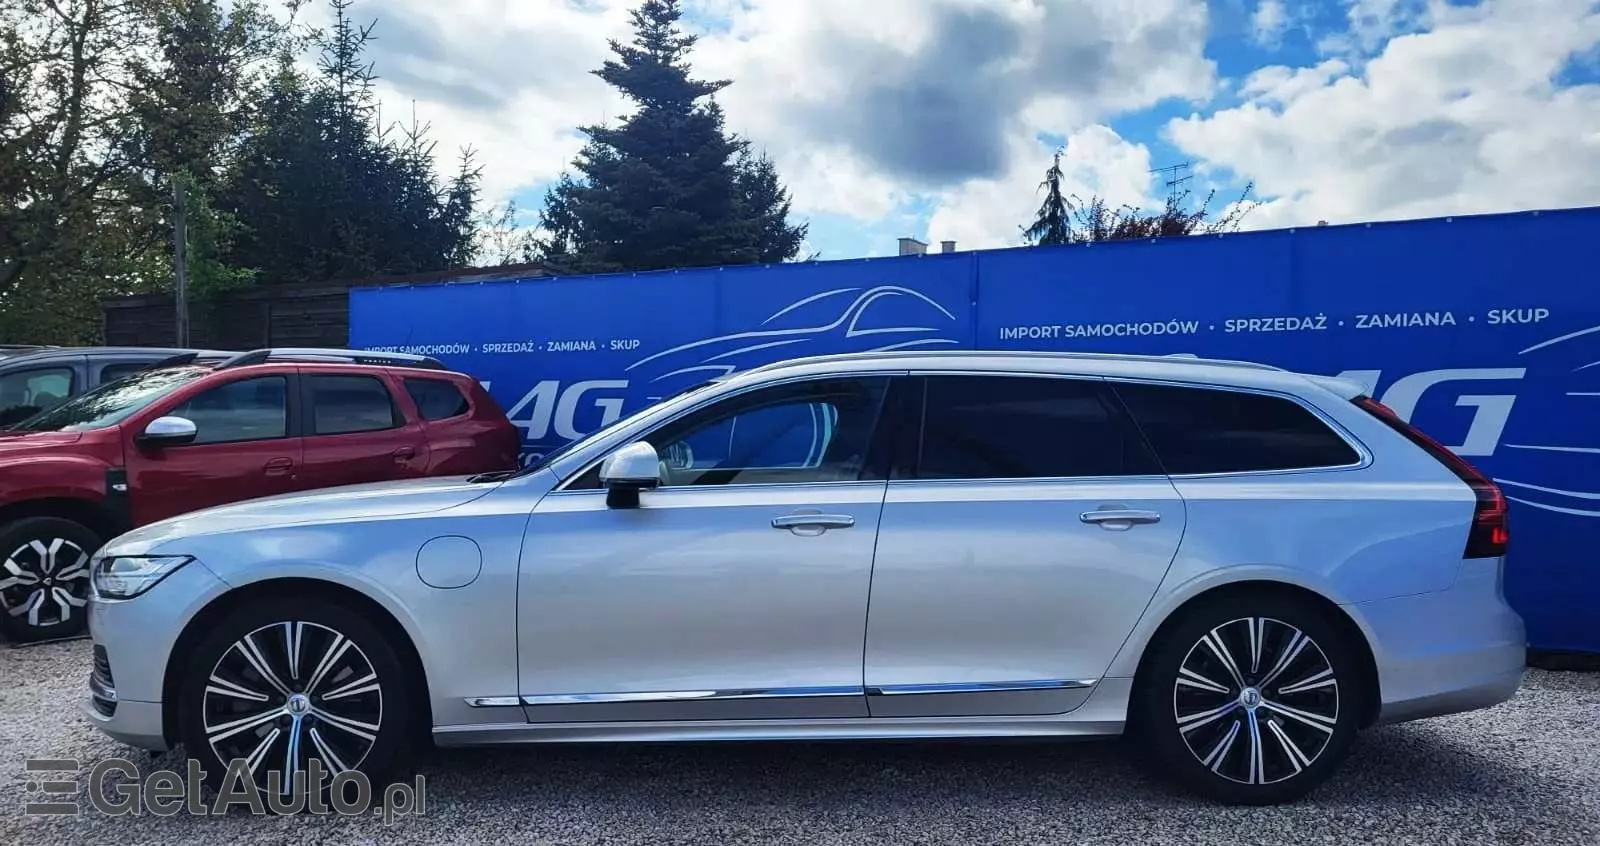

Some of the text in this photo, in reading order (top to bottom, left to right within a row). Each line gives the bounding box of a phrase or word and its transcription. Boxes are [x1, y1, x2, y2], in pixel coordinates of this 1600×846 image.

[1000, 308, 1549, 339] IMPORT SAMOCHODÓW SPRZEDAŻ ZAMIANA SKUP
[400, 343, 469, 354] SAMOCHODÓW
[482, 340, 534, 353] SPRZEDAŻ
[547, 340, 596, 352] ZAMIANA
[610, 339, 640, 350] SKUP
